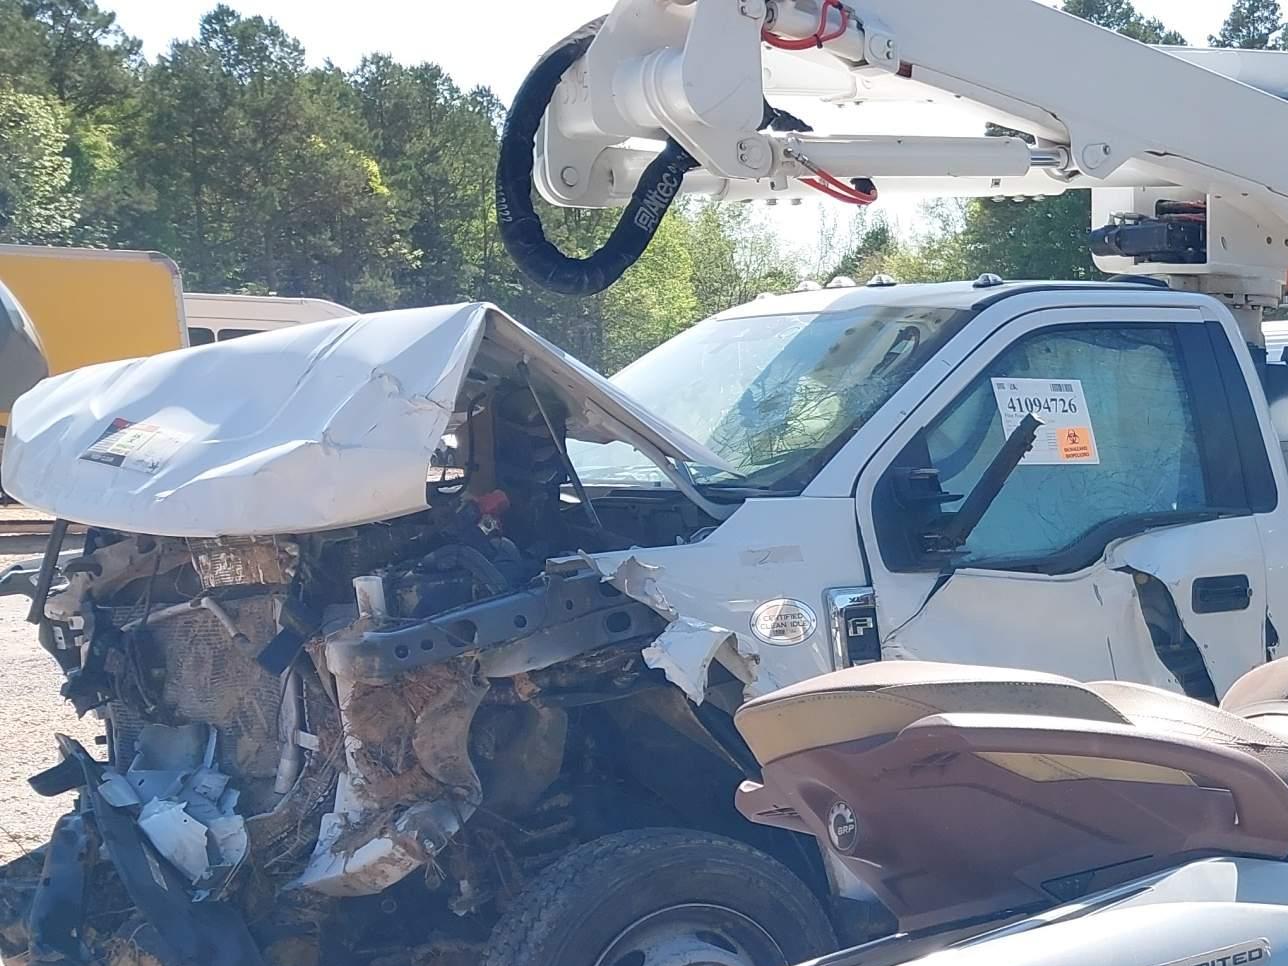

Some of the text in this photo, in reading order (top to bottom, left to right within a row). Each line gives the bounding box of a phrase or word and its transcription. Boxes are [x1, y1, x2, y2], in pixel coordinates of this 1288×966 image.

[1007, 397, 1078, 414] 41094726
[760, 621, 787, 630] CLEAN
[837, 824, 855, 836] BRP
